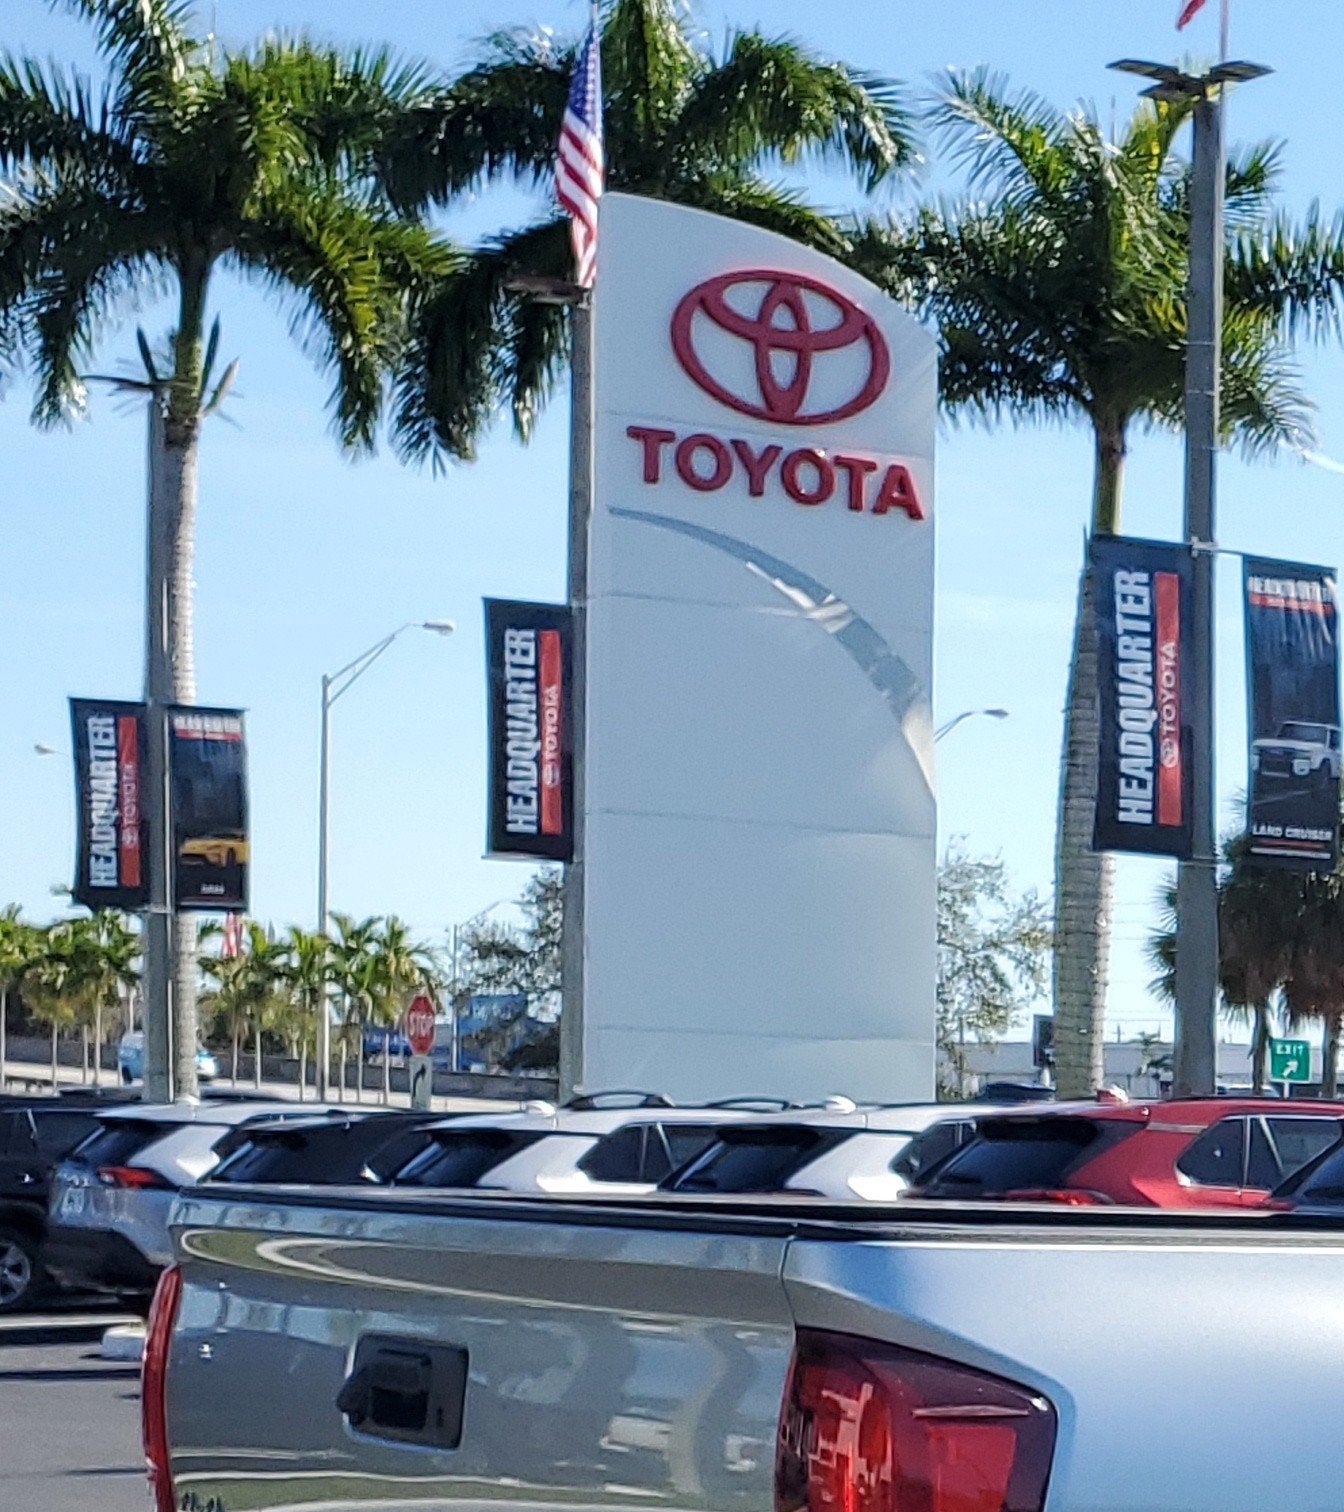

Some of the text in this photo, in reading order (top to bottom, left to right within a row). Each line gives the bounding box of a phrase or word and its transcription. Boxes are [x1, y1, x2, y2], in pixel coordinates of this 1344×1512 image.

[626, 425, 924, 521] TOYOTA
[505, 629, 541, 834] HEADQUARTER
[545, 686, 559, 762] TOYOTA
[1114, 569, 1157, 824] HEADQUARTER
[1161, 641, 1177, 733] TOYOTA
[87, 717, 119, 887] HEADQUARTER
[409, 1012, 433, 1037] STOP
[1276, 1044, 1304, 1057] EXIT
